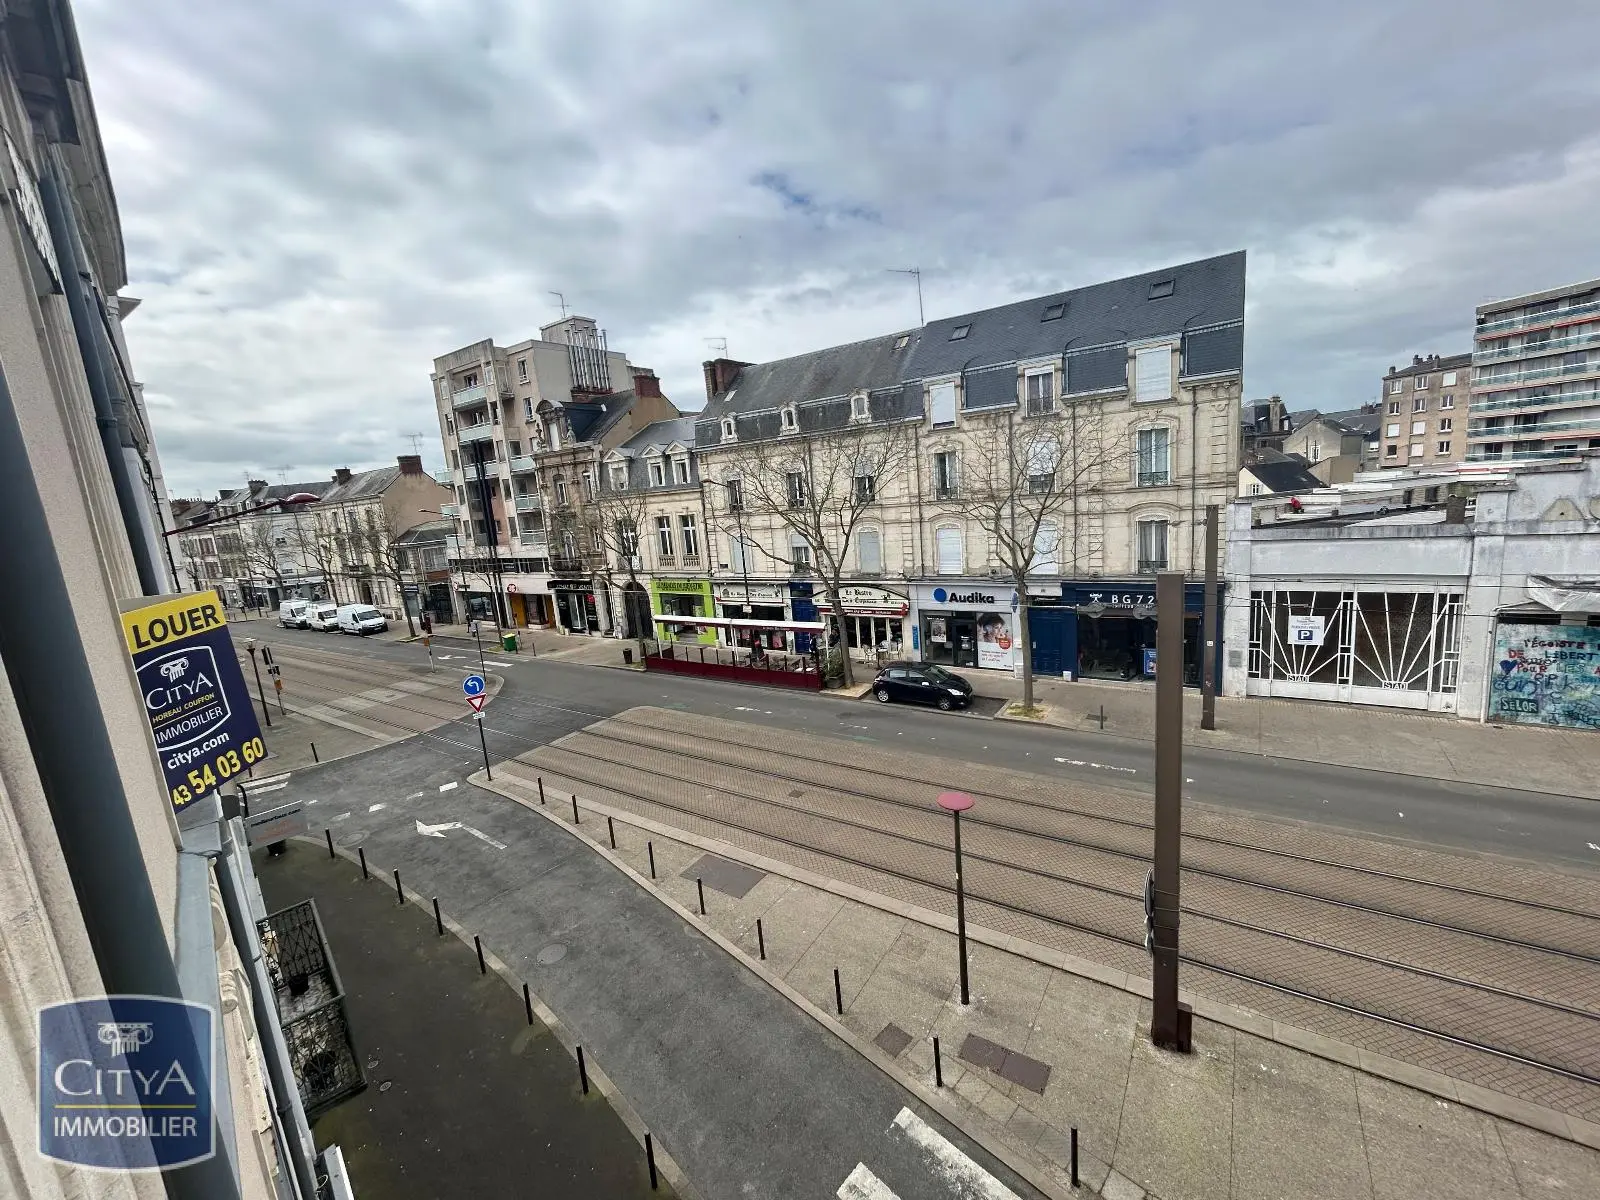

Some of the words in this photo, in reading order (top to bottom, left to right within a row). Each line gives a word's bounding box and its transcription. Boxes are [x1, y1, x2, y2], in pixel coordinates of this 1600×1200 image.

[949, 592, 995, 604] Audika
[132, 604, 220, 649] LOUER
[146, 671, 213, 710] CITYA
[152, 706, 182, 723] HOREAU
[184, 692, 215, 710] COUFFON
[155, 706, 224, 744] IMMOBILIER
[167, 732, 230, 769] citya.com
[171, 784, 192, 805] 43
[187, 763, 217, 794] 54
[216, 750, 241, 778] 03
[242, 737, 264, 763] 60
